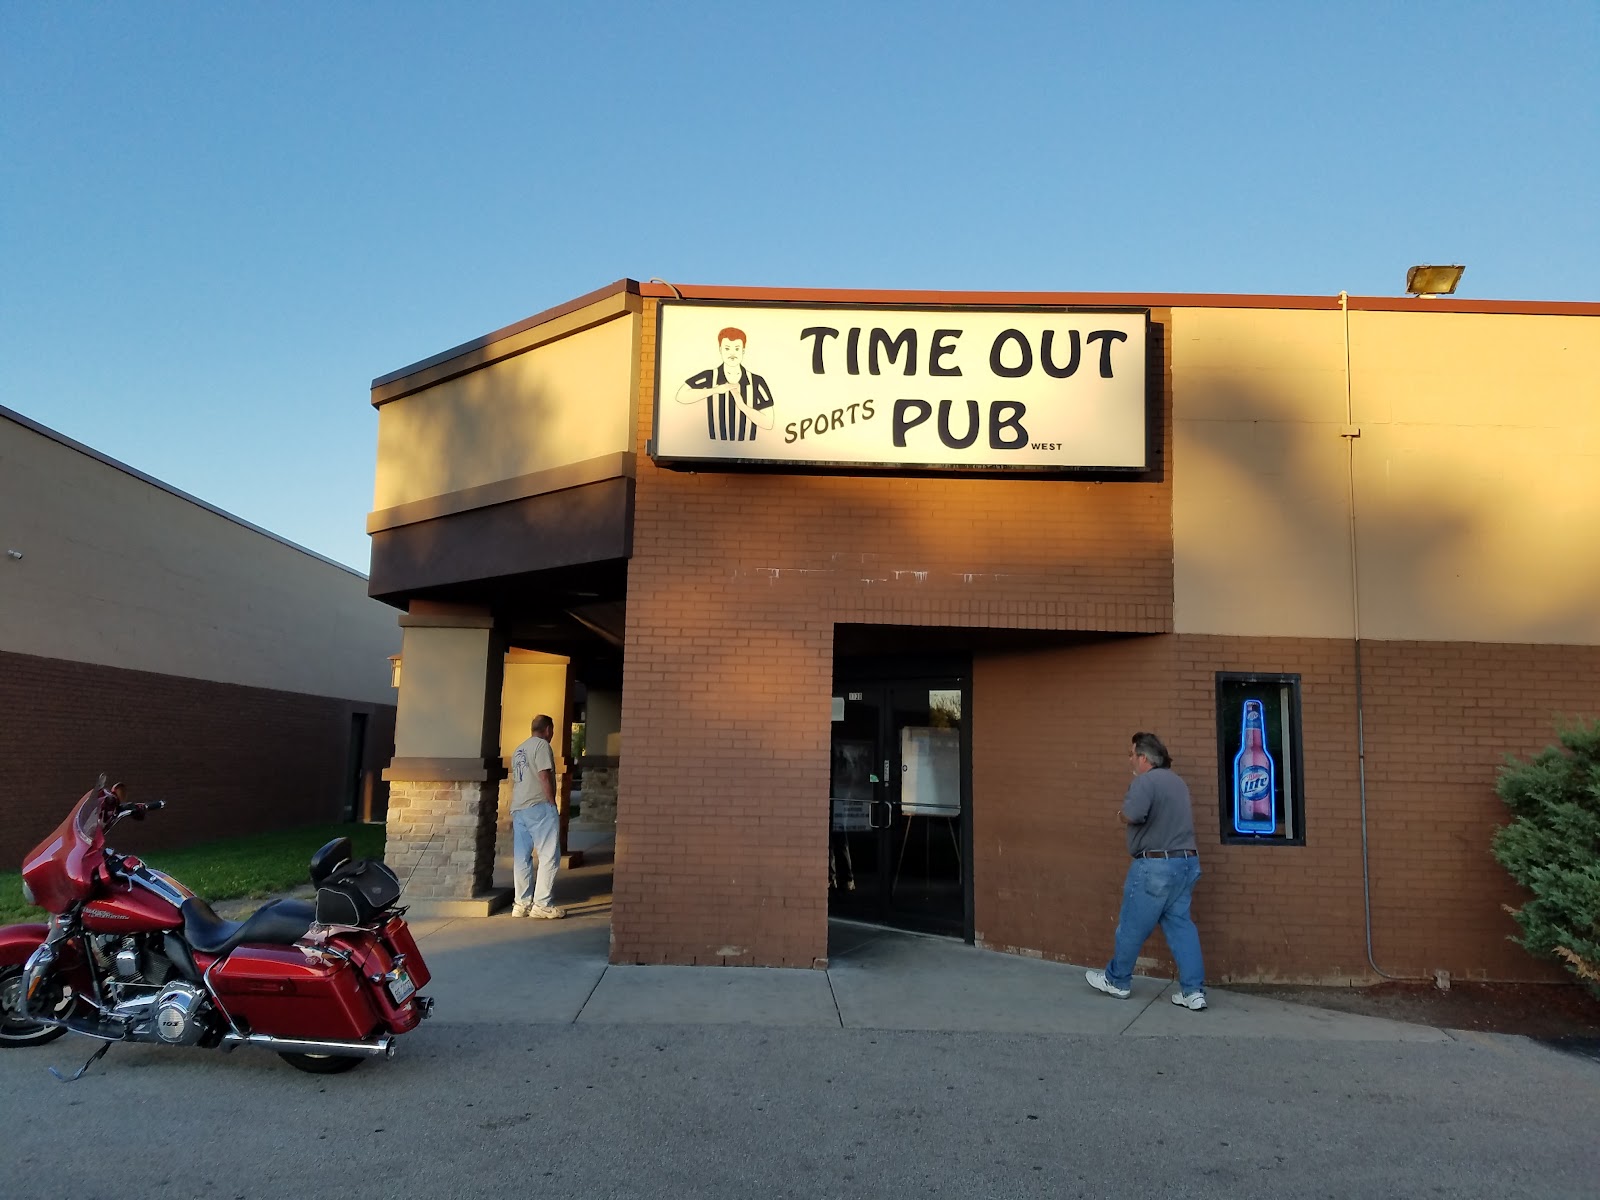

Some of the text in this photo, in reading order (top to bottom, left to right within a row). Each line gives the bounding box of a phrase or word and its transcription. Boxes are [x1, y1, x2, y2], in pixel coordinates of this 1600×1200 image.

[801, 327, 1128, 378] TIME OUT
[785, 398, 1063, 451] SPORTS PUB WEST
[1244, 777, 1268, 794] Lite
